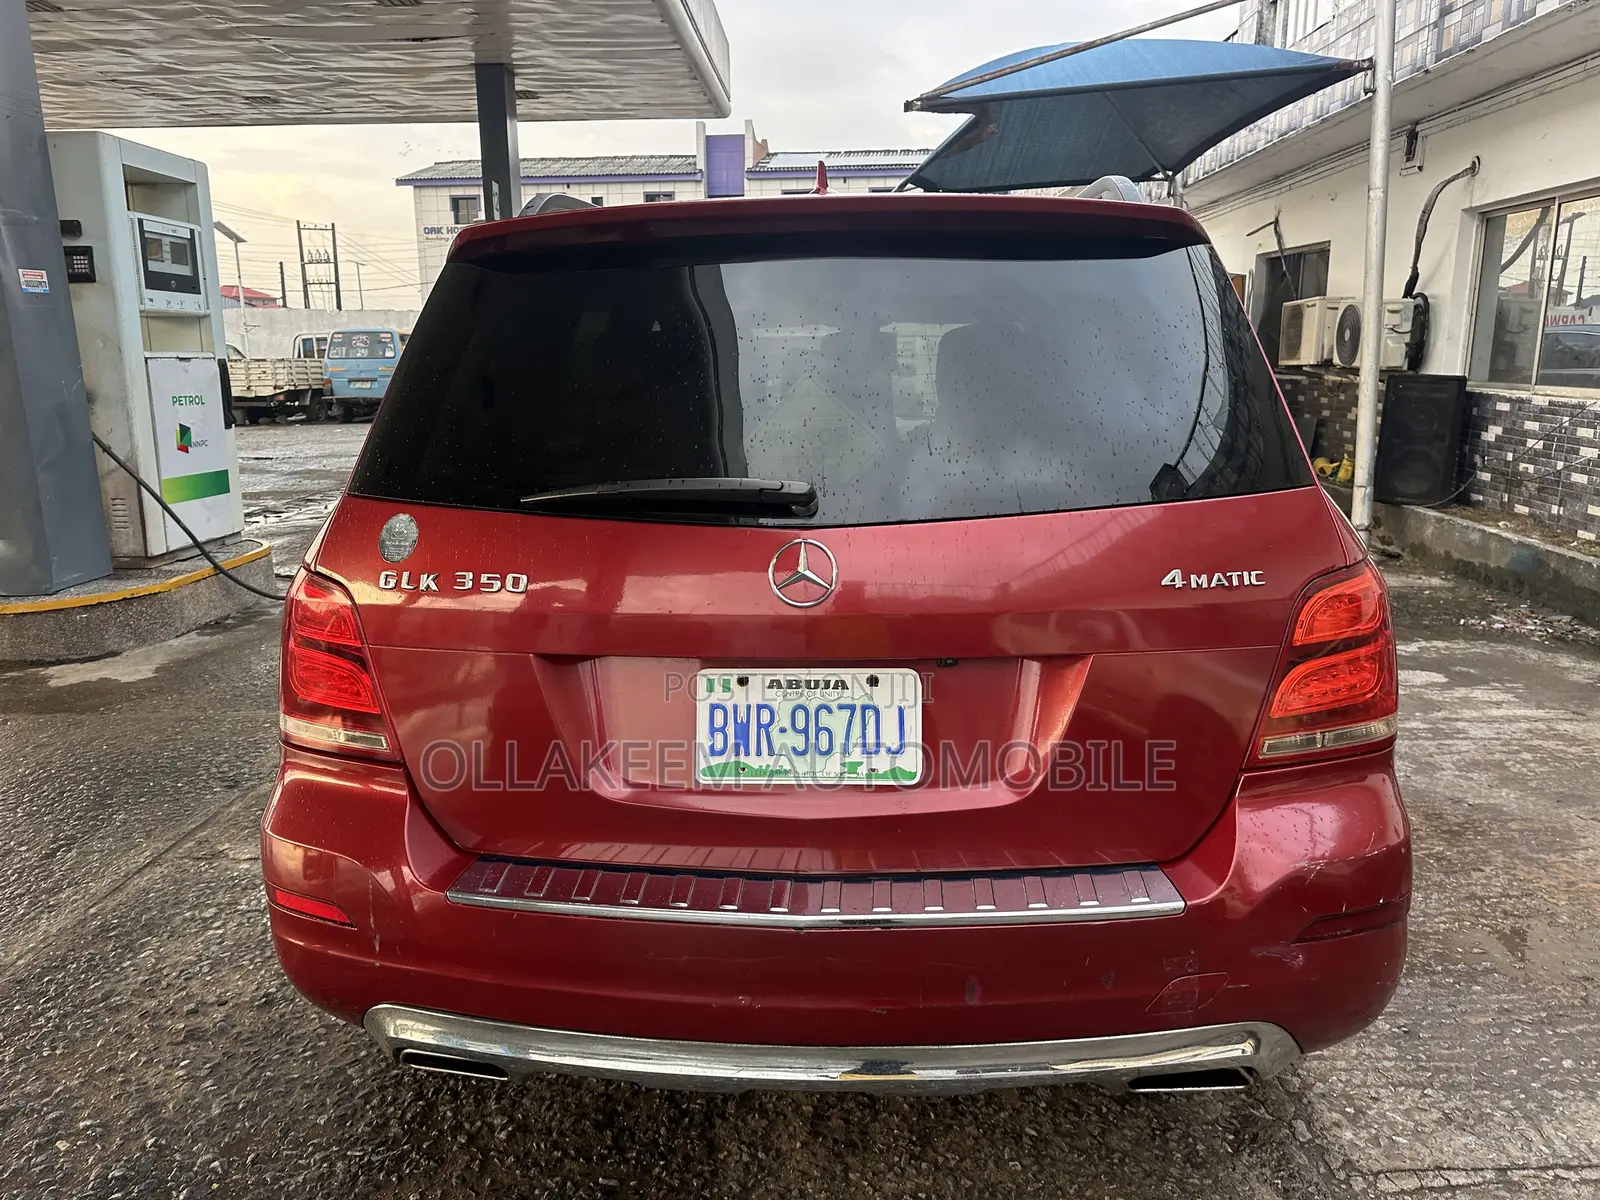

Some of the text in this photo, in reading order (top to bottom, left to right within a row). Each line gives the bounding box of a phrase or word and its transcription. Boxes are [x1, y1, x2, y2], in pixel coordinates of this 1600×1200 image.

[446, 226, 462, 235] HO
[171, 394, 206, 407] PETROL
[192, 439, 209, 448] NNPC
[379, 570, 529, 593] GLK 350
[766, 678, 850, 690] ABUJA
[775, 690, 841, 699] CENTRE OF UNITY
[708, 703, 906, 757] BWR-967DJ
